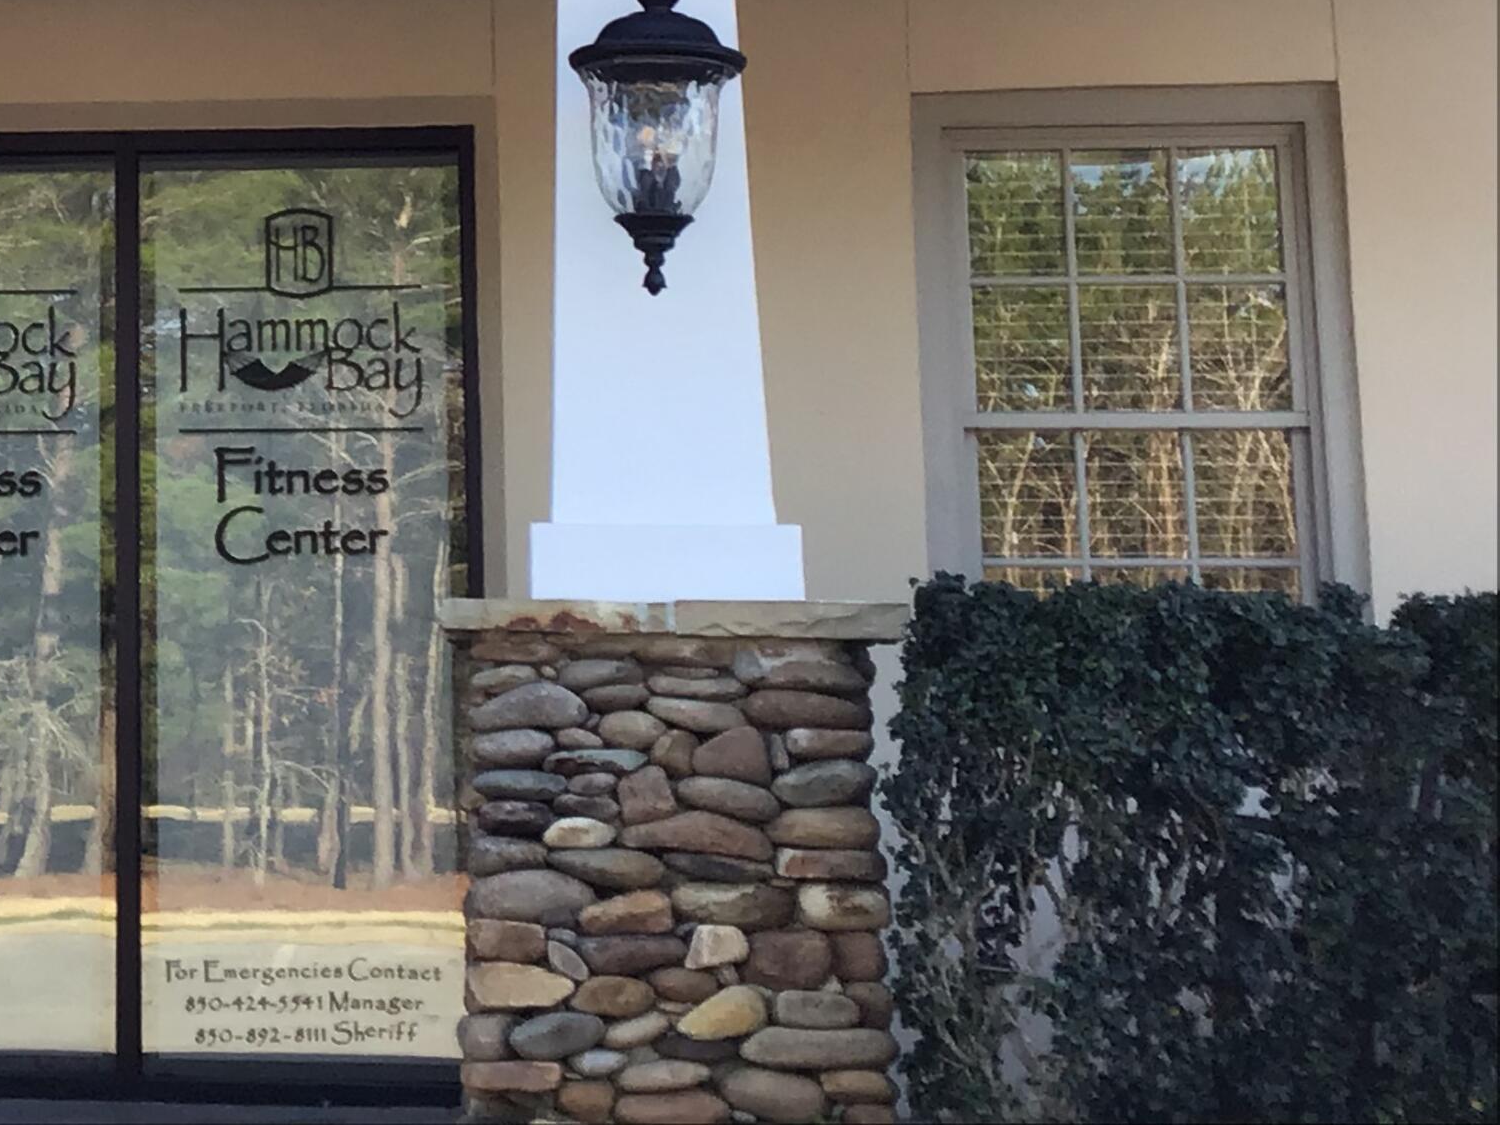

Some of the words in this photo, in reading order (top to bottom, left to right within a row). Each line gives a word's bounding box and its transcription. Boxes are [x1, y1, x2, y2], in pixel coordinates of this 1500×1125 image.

[268, 224, 326, 284] HB
[179, 301, 421, 393] Hammock
[326, 347, 423, 419] Bay
[214, 446, 390, 503] Fitness
[214, 505, 389, 565] Center
[165, 959, 198, 983] For
[203, 959, 343, 987] Emergencies
[347, 957, 442, 982] Contact
[185, 995, 323, 1015] 850-424-5541
[328, 990, 425, 1015] Manager
[194, 1026, 327, 1047] 850-892-8111
[331, 1020, 419, 1046] Sheriff
